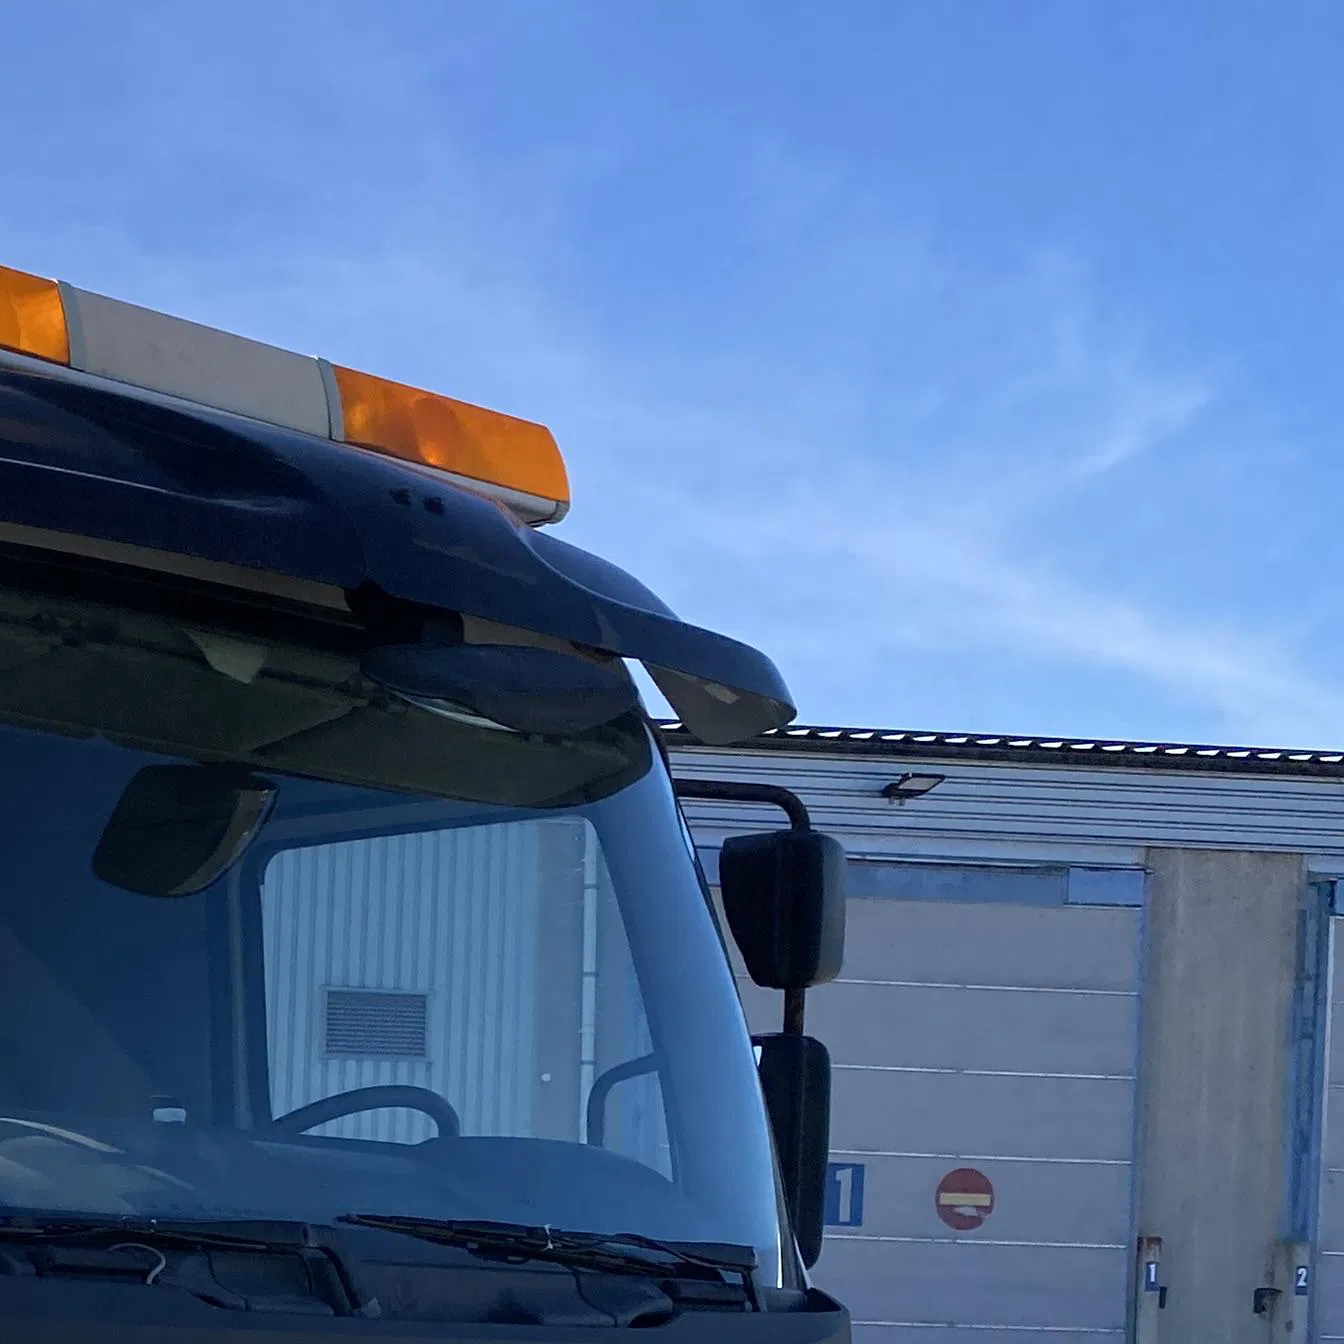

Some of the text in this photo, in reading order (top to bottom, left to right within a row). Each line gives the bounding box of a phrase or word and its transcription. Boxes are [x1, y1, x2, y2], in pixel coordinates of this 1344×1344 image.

[835, 1167, 853, 1223] 1
[1148, 1262, 1157, 1283] 1
[1296, 1267, 1308, 1288] 2
